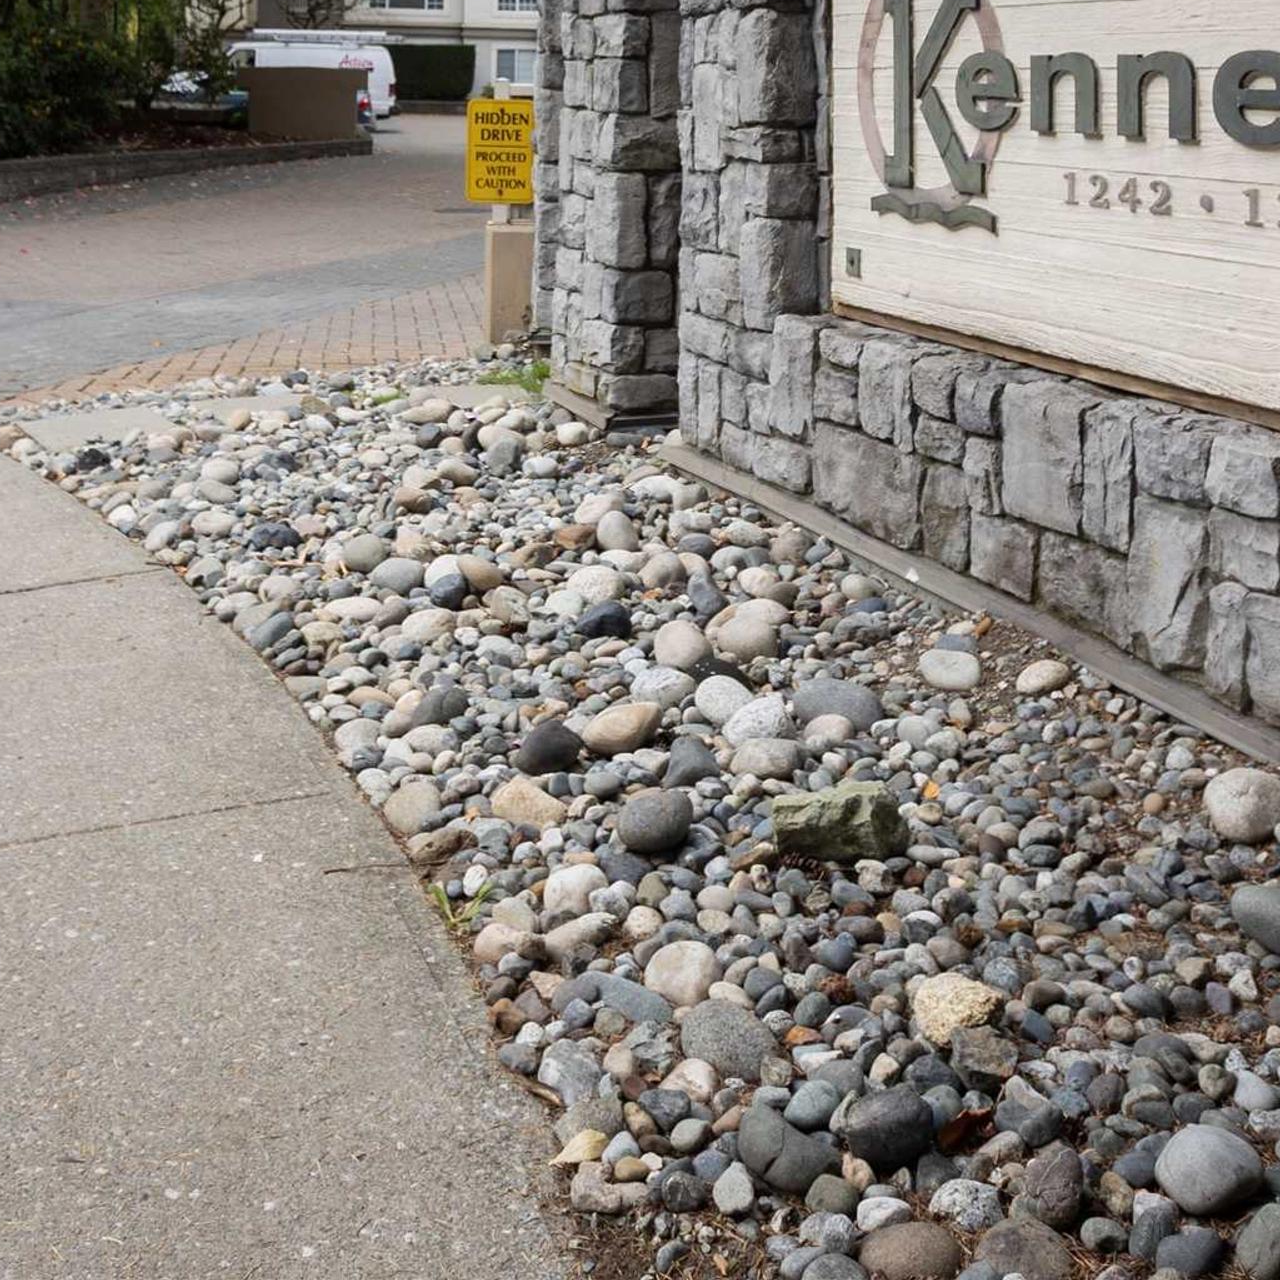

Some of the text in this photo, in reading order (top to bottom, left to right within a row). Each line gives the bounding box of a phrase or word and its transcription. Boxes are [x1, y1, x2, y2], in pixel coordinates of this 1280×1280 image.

[474, 111, 529, 125] HIDDEN
[481, 129, 522, 141] DRIVE
[476, 151, 527, 162] PROCEED
[486, 166, 516, 176] WITH
[475, 178, 526, 189] CAUTION
[1063, 172, 1173, 216] 1242
